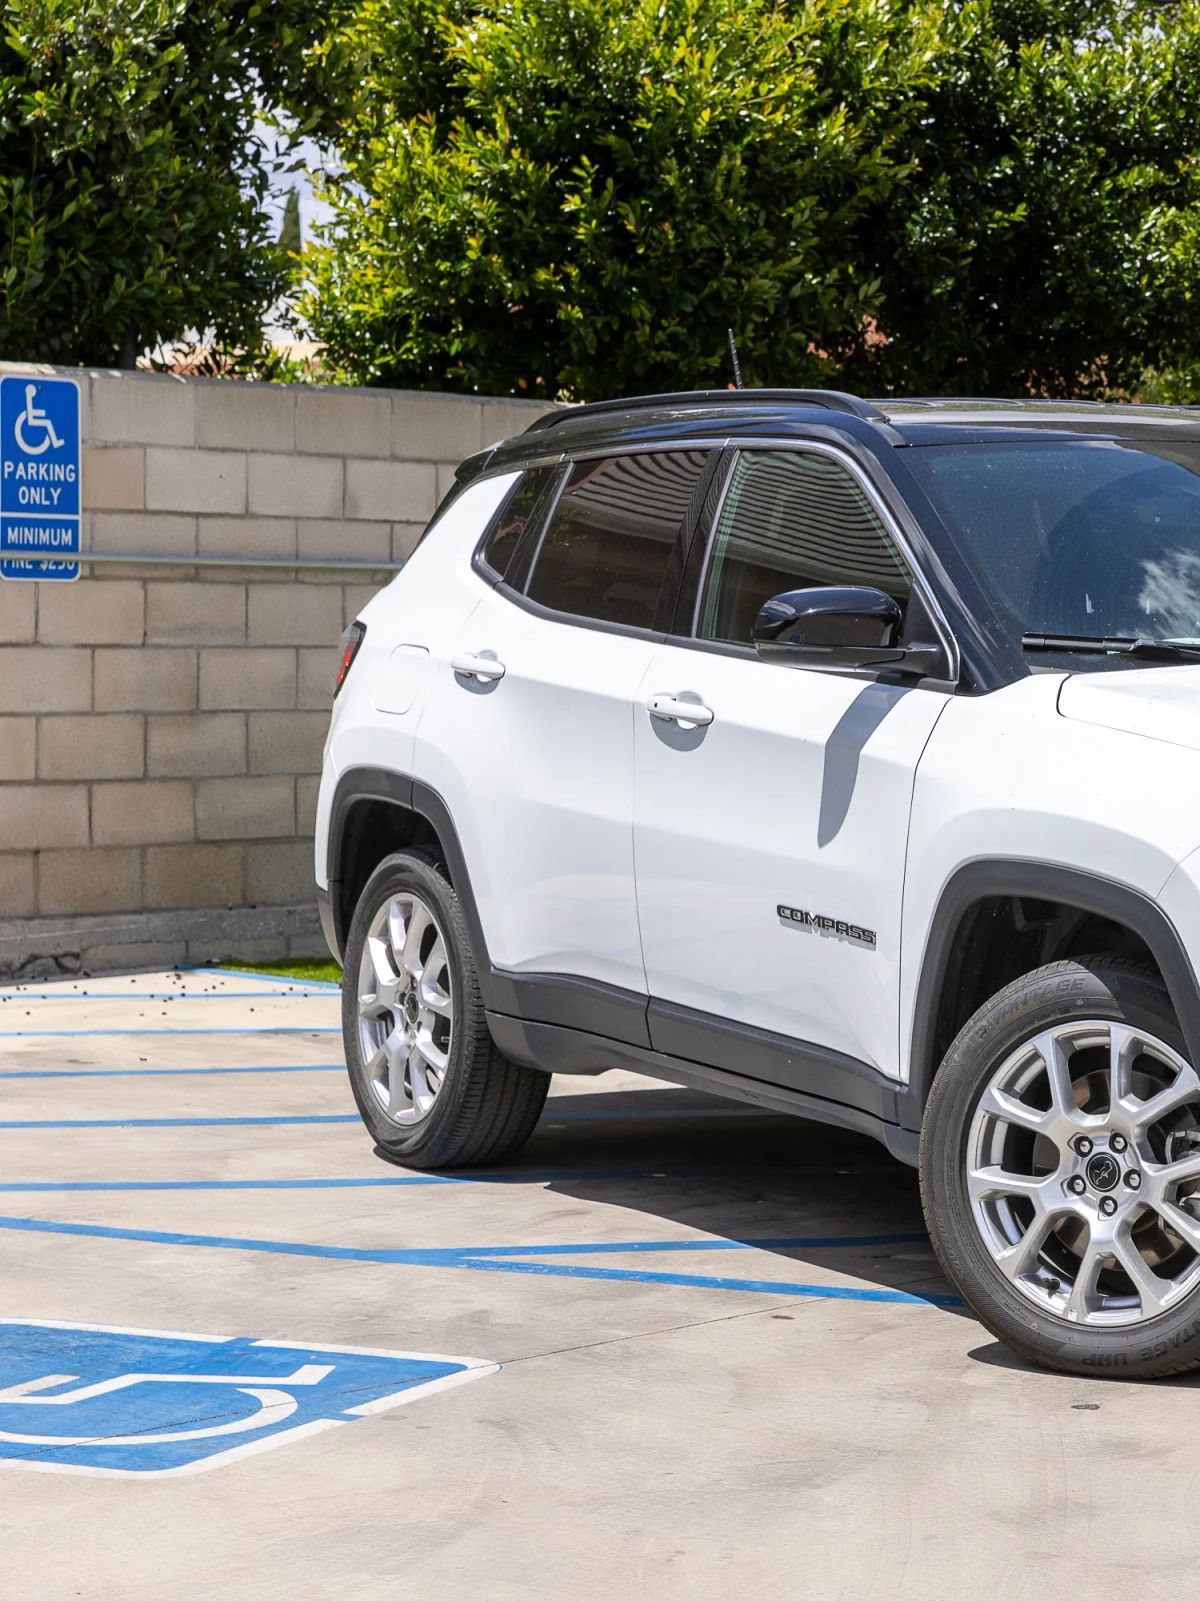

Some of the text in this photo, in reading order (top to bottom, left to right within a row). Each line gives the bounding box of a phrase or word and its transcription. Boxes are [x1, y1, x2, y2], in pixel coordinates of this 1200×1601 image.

[4, 461, 76, 482] PARKING
[18, 486, 62, 505] ONLY
[7, 526, 73, 546] MINIMUM
[776, 904, 877, 945] COMPASS
